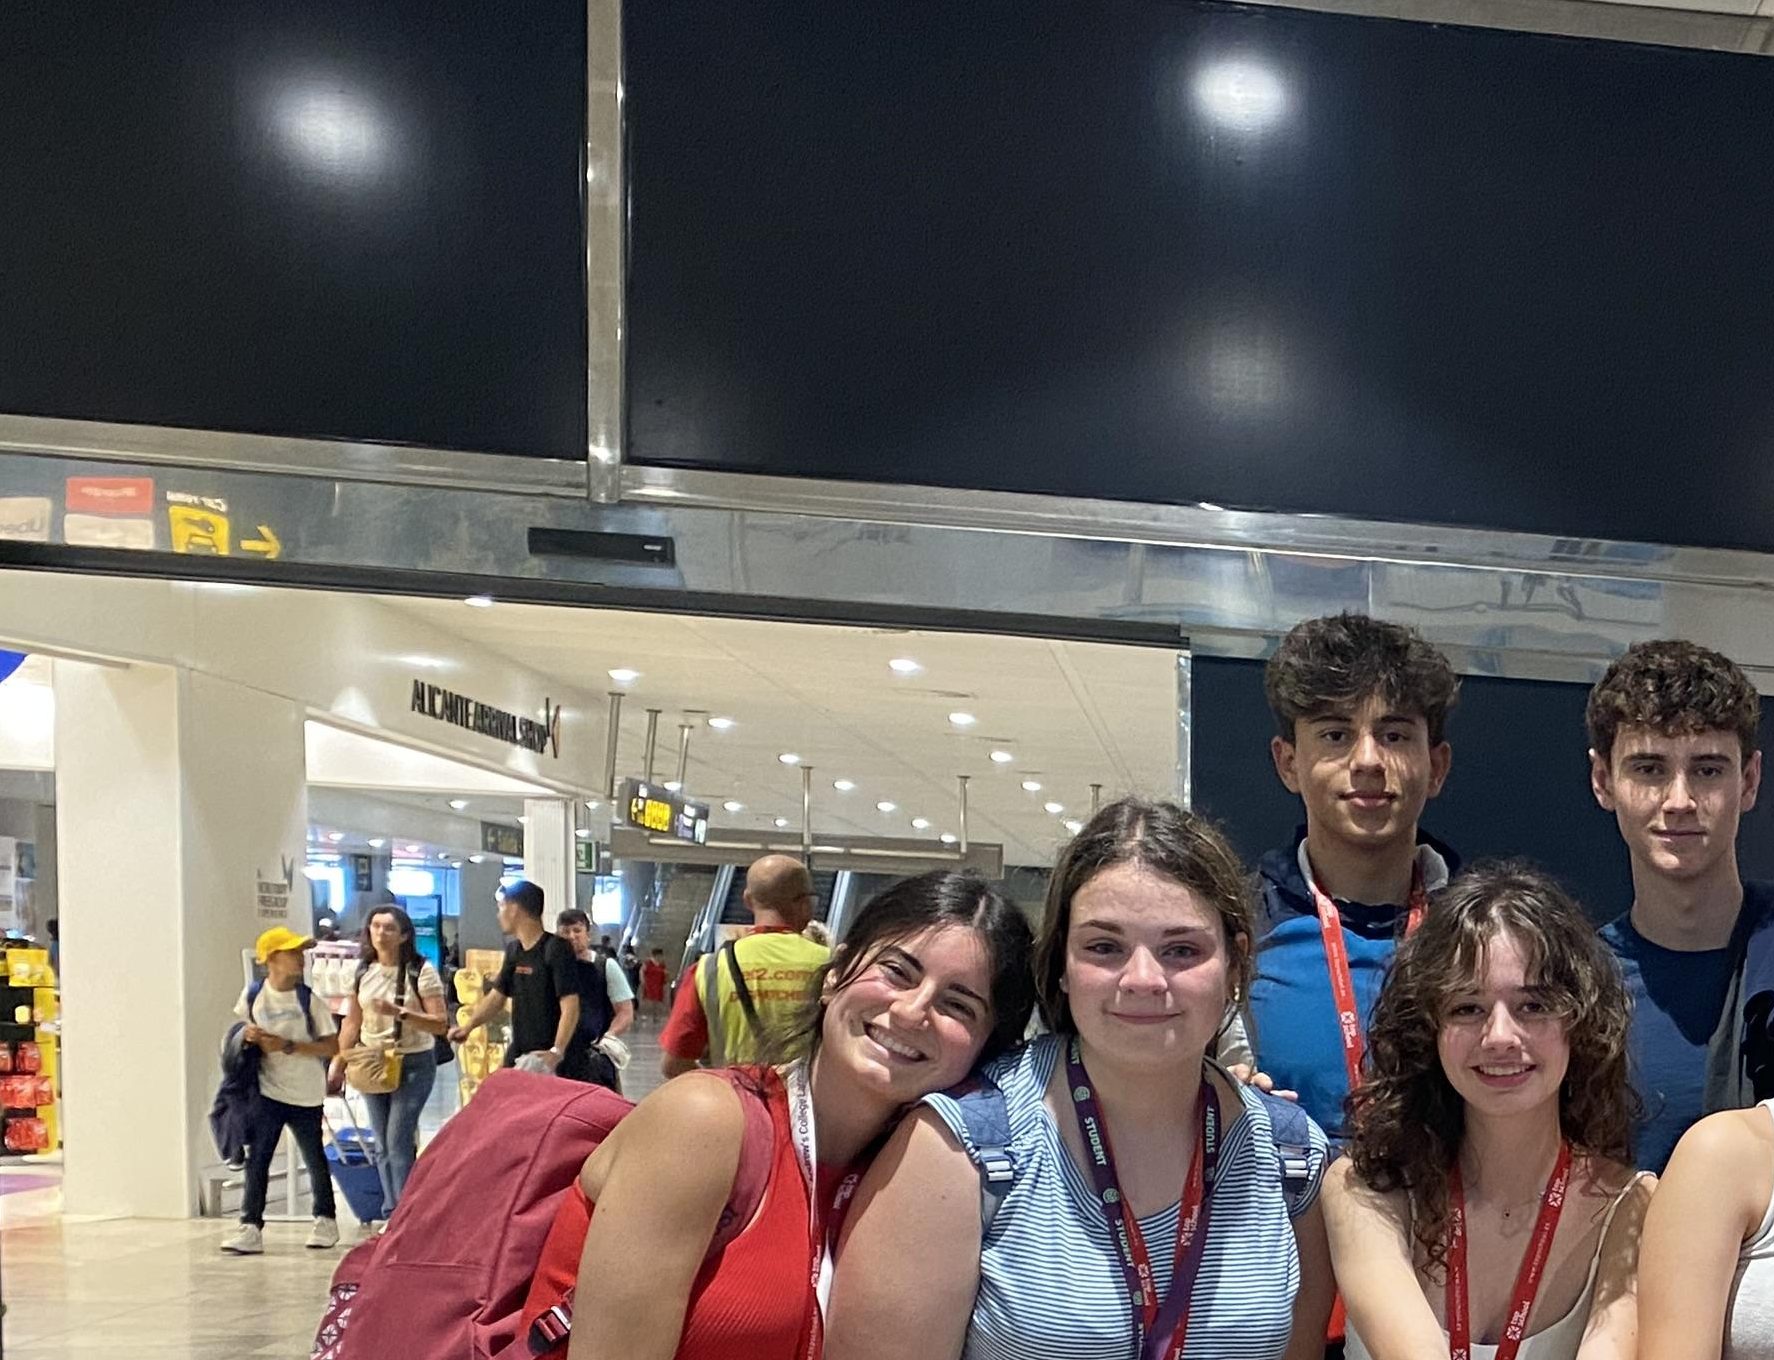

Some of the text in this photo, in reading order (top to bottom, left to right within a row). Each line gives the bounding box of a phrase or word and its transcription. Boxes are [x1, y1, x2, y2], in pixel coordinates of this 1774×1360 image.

[411, 678, 548, 755] ALICANTE ARRIVAL SHOP
[1084, 1116, 1107, 1167] STUDENT
[1206, 1105, 1215, 1154] STUDENT
[1115, 1218, 1135, 1269] STUDENT
